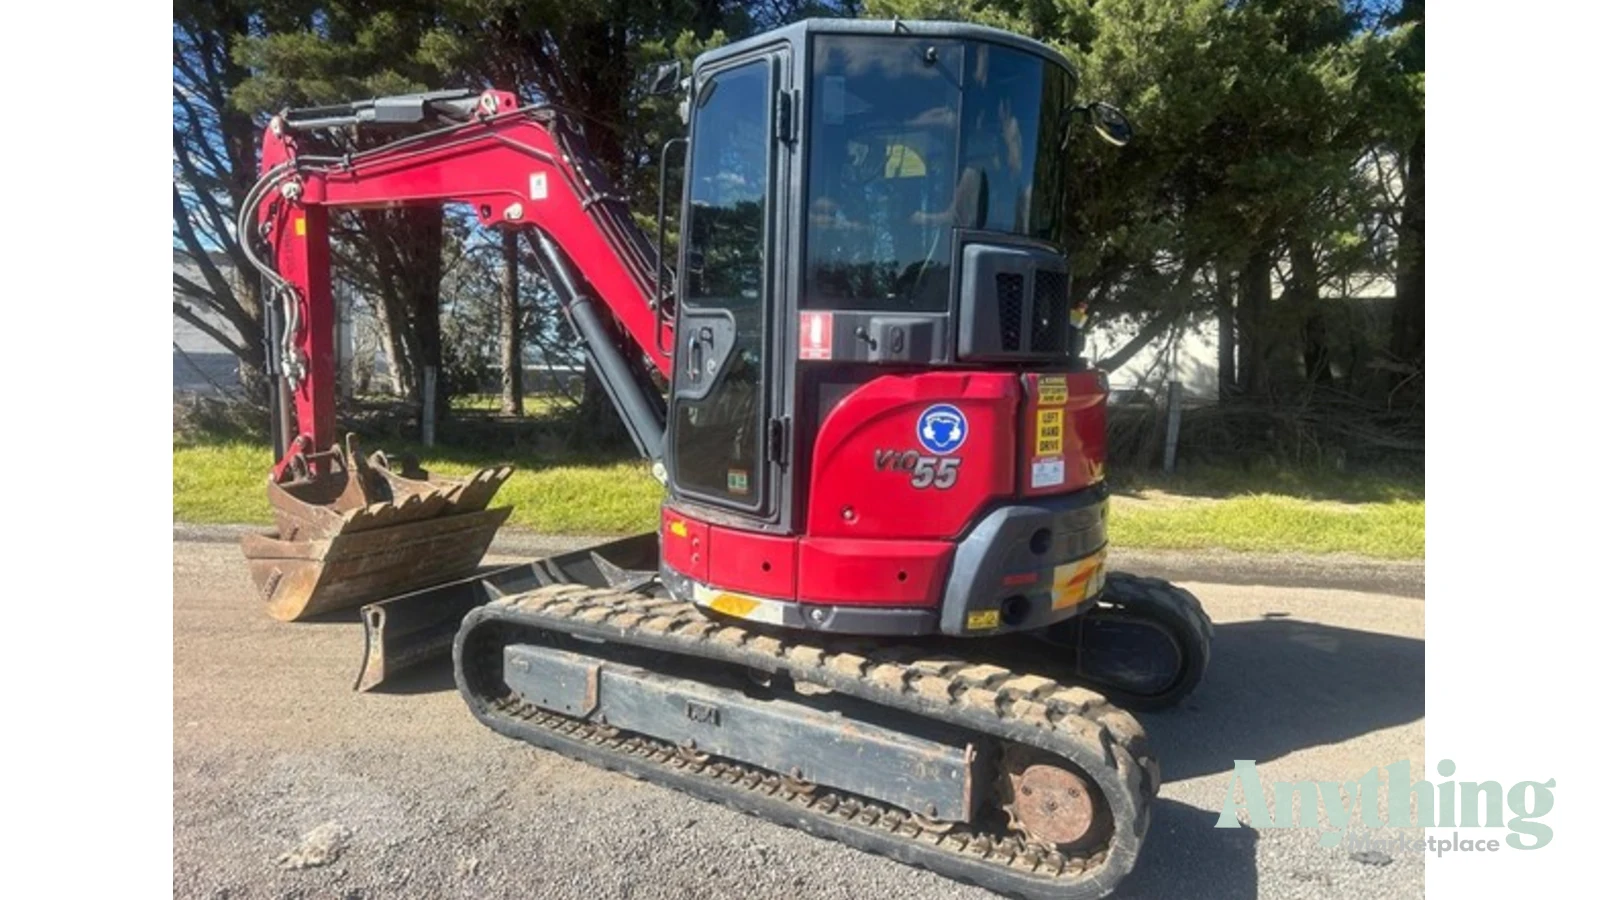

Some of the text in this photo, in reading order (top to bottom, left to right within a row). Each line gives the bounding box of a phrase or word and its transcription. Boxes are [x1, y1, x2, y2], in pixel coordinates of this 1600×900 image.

[1042, 411, 1059, 424] LEFT
[1041, 426, 1059, 437] HAND
[1039, 440, 1059, 452] DRIVE
[911, 456, 962, 490] 55
